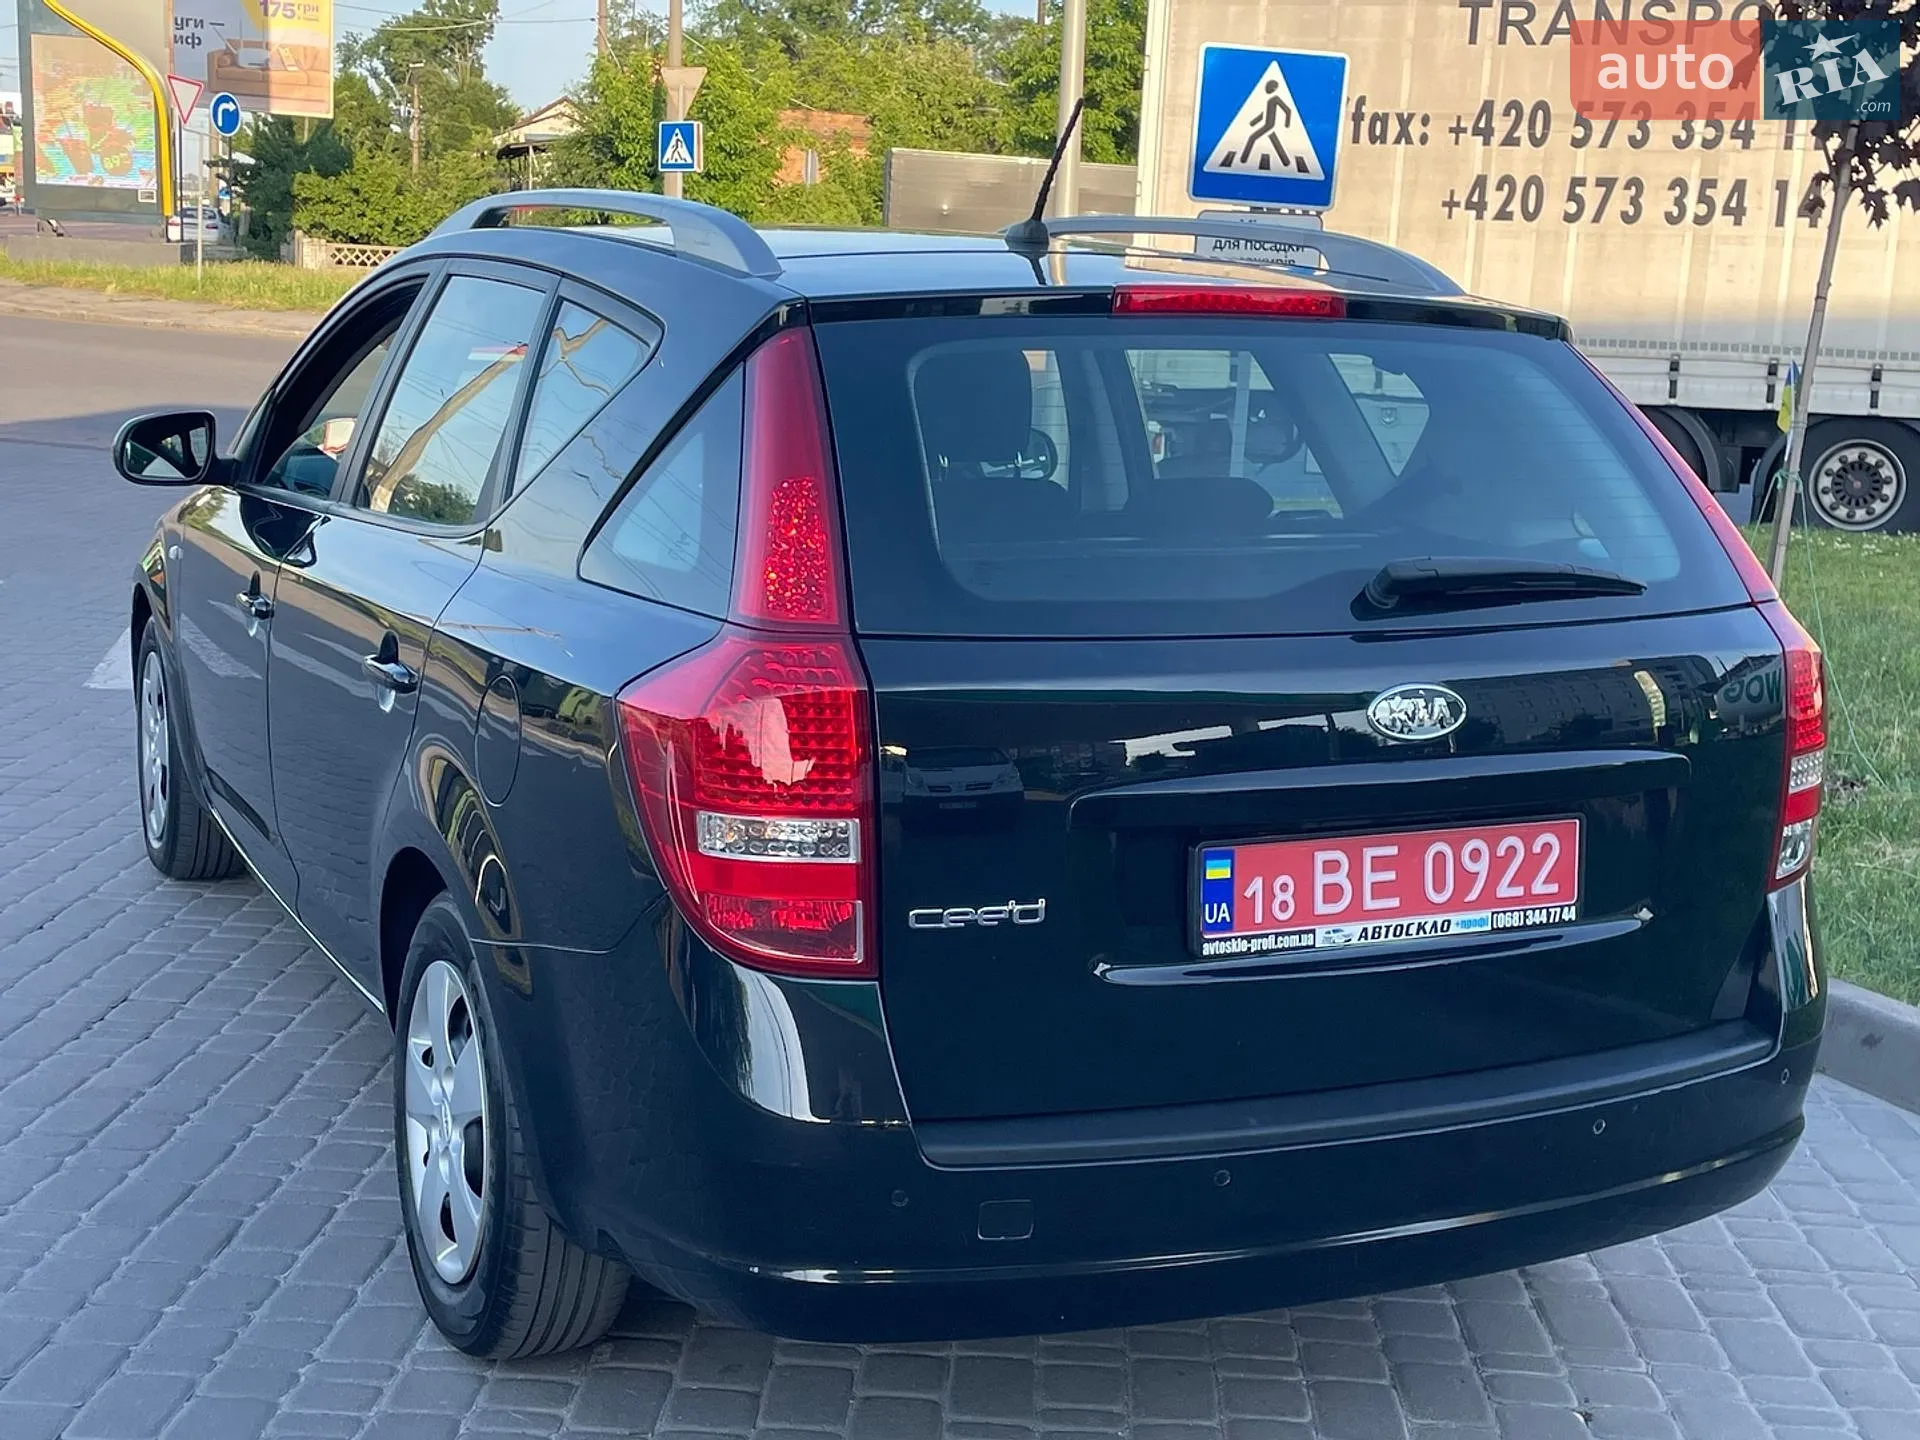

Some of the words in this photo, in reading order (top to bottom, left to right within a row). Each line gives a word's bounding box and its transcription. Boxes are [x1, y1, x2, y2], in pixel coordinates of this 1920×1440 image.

[260, 0, 296, 19] 175
[1346, 94, 1430, 146] fax:
[1448, 99, 1552, 149] +420
[1570, 101, 1653, 150] 573
[1672, 101, 1756, 151] 354
[1441, 174, 1544, 223] +420
[1563, 176, 1644, 225] 573
[1664, 177, 1747, 227] 354
[1775, 178, 1828, 229] 14
[1213, 239, 1240, 253] для
[1243, 874, 1296, 925] 18
[1313, 845, 1400, 916] BE
[1423, 832, 1561, 905] 0922
[1205, 903, 1231, 924] UA
[1525, 908, 1548, 927] 344
